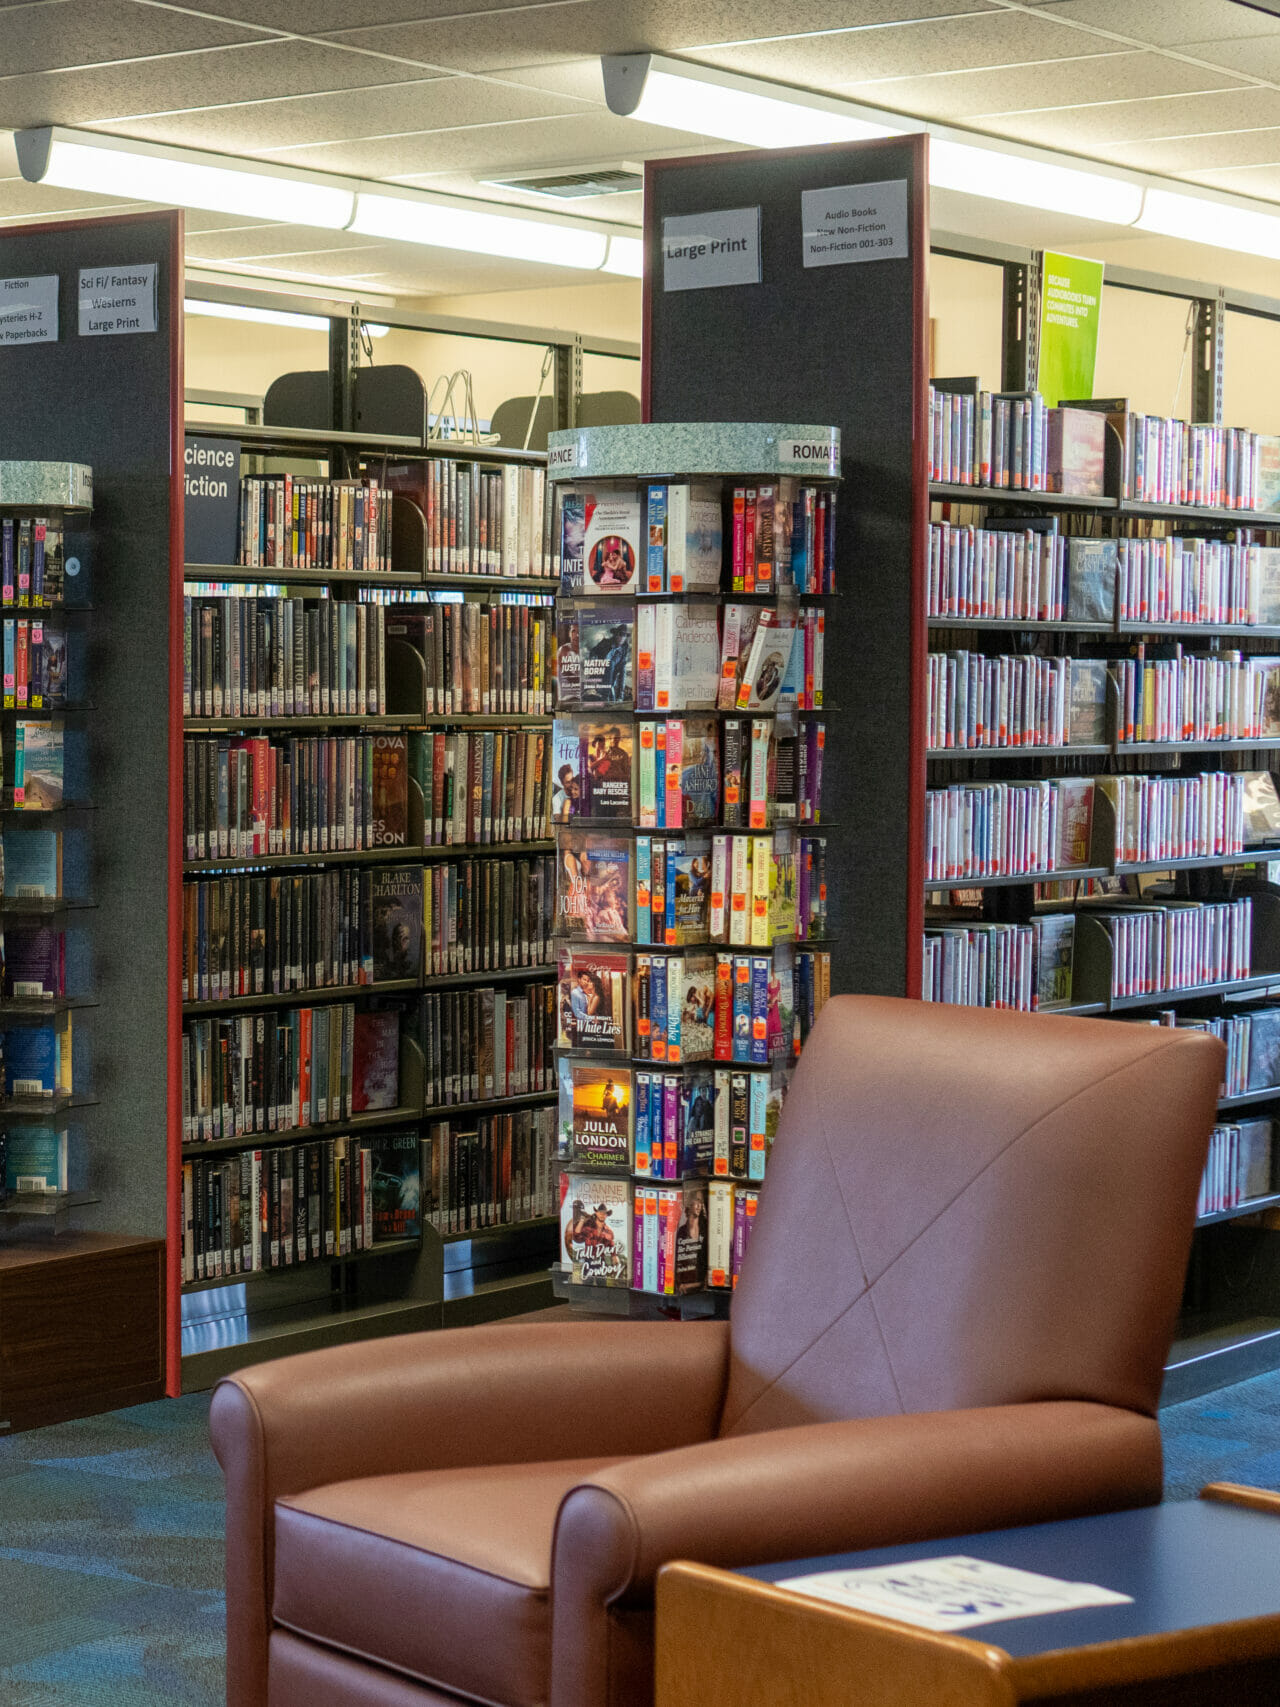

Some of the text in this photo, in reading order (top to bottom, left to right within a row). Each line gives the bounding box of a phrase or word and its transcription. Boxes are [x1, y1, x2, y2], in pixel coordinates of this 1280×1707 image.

[824, 207, 878, 220] Audio Books
[816, 222, 886, 237] New Non-Fiction
[666, 237, 748, 262] Large Print
[810, 237, 894, 254] Non-Fiction 001-303
[4, 281, 29, 290] Fiction
[80, 275, 148, 289] Sci Fi/ Fantasy
[92, 298, 136, 310] Westerns
[1082, 294, 1096, 306] TURN
[30, 312, 42, 320] H-Z
[88, 318, 140, 332] Large Print
[5, 328, 48, 341] Paperbacks
[184, 443, 235, 468] cience
[184, 475, 228, 497] iction
[564, 560, 584, 572] INTE
[676, 630, 718, 644] Anderson
[295, 625, 304, 688] NINTH HOU
[560, 664, 581, 674] JUSTI
[584, 659, 610, 668] NATIVE
[584, 667, 605, 676] BORN
[474, 738, 482, 784] MARTIN
[592, 788, 628, 797] BABY RESCUE
[382, 872, 410, 884] BLAKE
[572, 876, 588, 895] JOA
[560, 896, 588, 915] JOHN
[576, 1018, 622, 1035] White Lies
[583, 1120, 618, 1134] JULIA
[393, 1138, 416, 1150] GREEN
[575, 1134, 627, 1148] LONDON
[587, 1152, 624, 1161] CHARMER
[578, 1184, 623, 1196] JOANNE
[576, 1194, 626, 1206] KENNEDY
[581, 1261, 626, 1280] Cowboy
